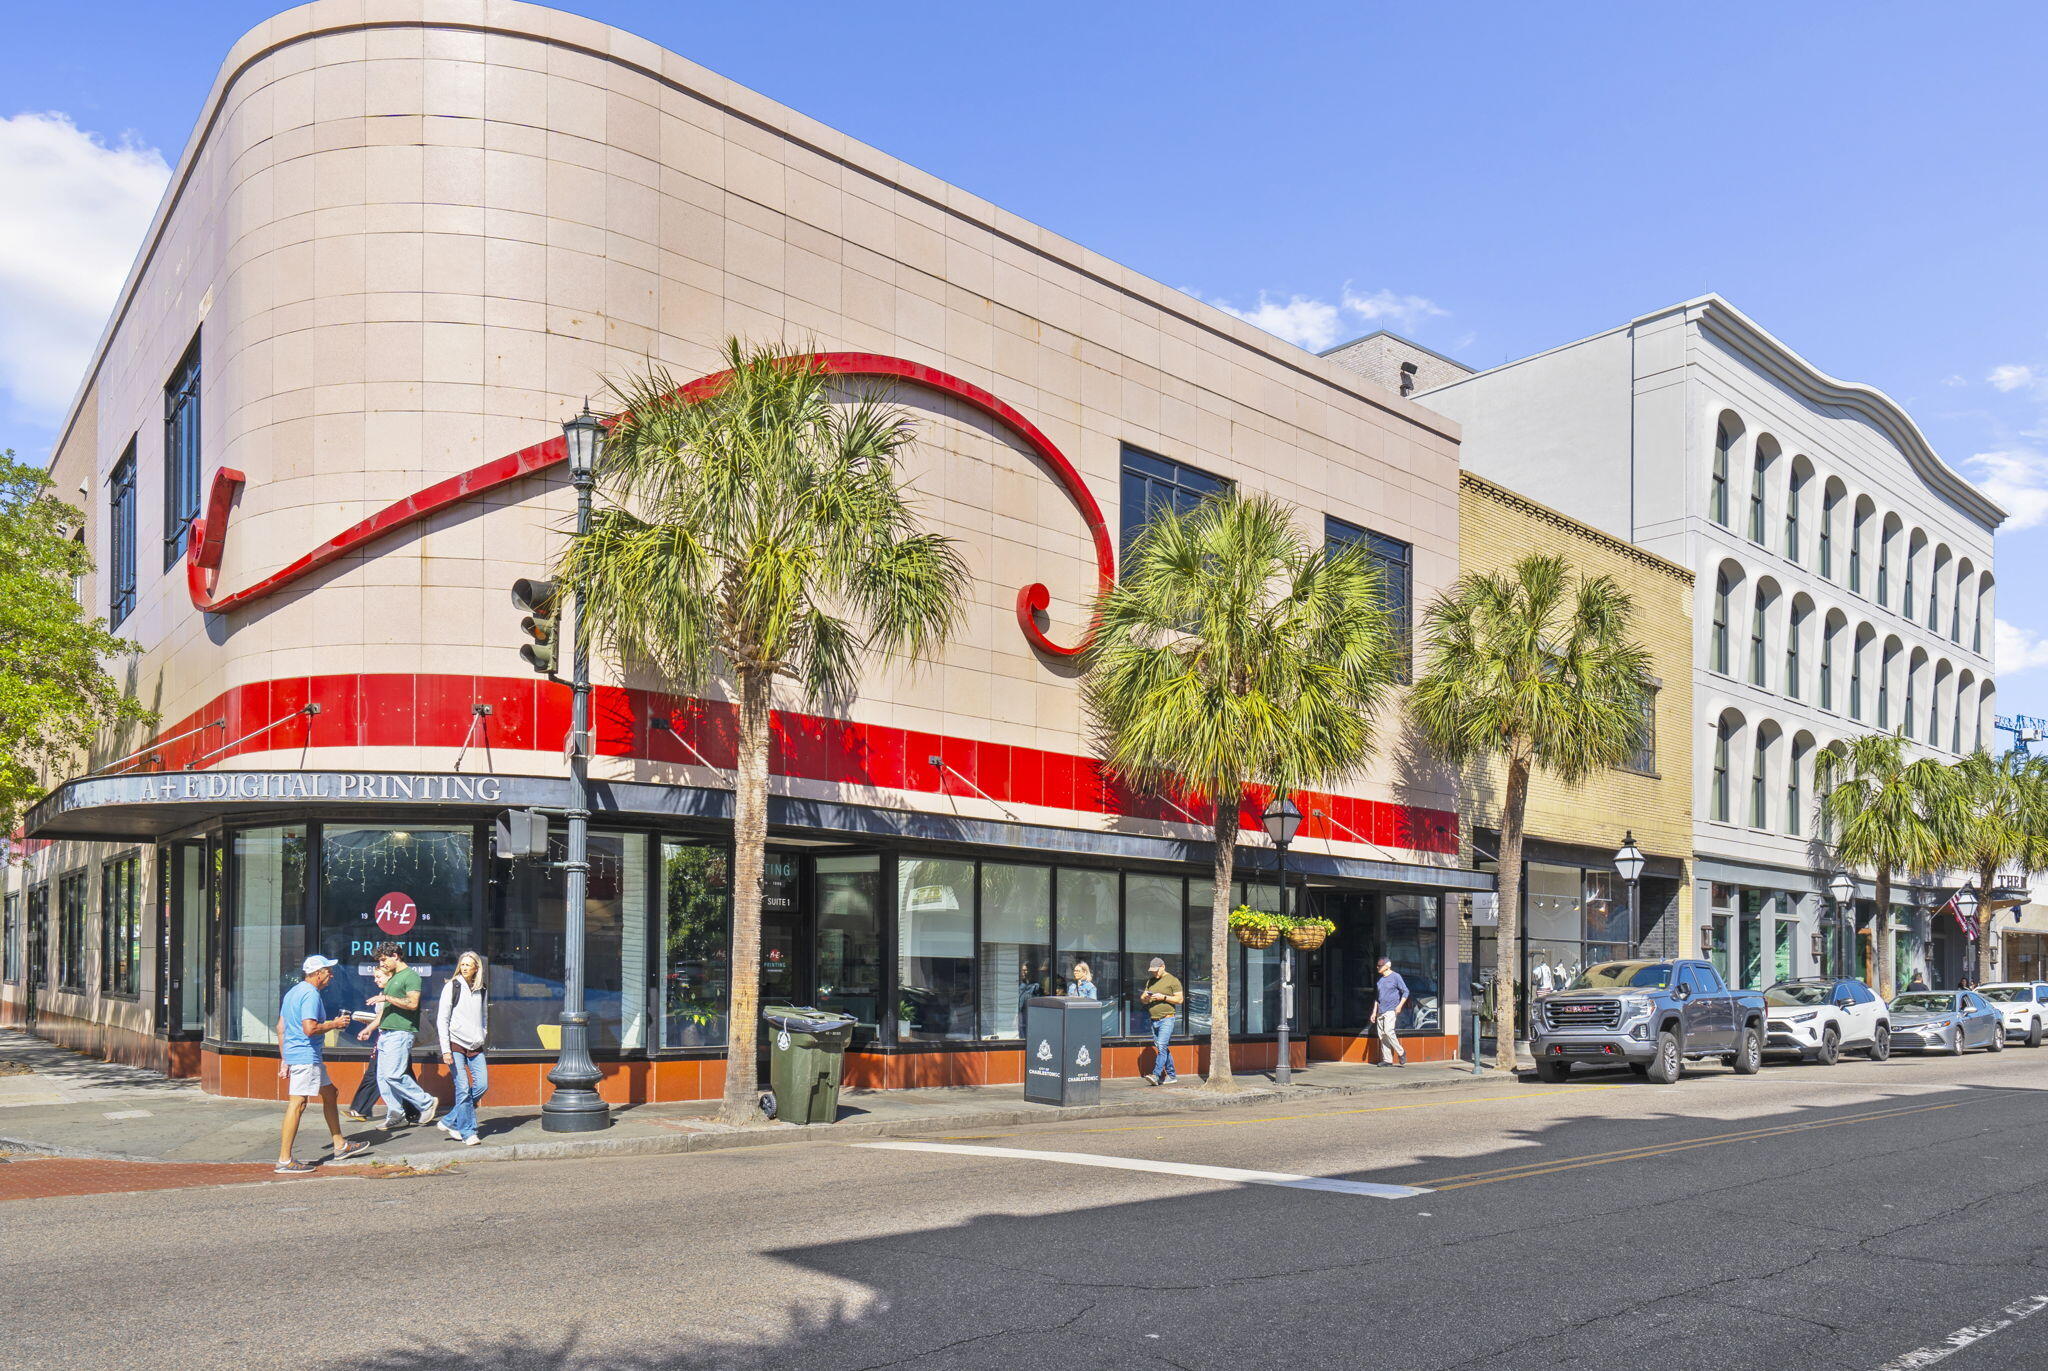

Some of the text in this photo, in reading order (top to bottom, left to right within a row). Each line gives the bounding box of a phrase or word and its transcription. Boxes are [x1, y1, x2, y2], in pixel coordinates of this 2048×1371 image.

[208, 774, 329, 798] DIGITAL
[338, 774, 501, 801] PRINTING
[361, 900, 431, 924] 19 A+E 96
[767, 898, 791, 907] SUITE 1
[351, 940, 440, 957] PRTING
